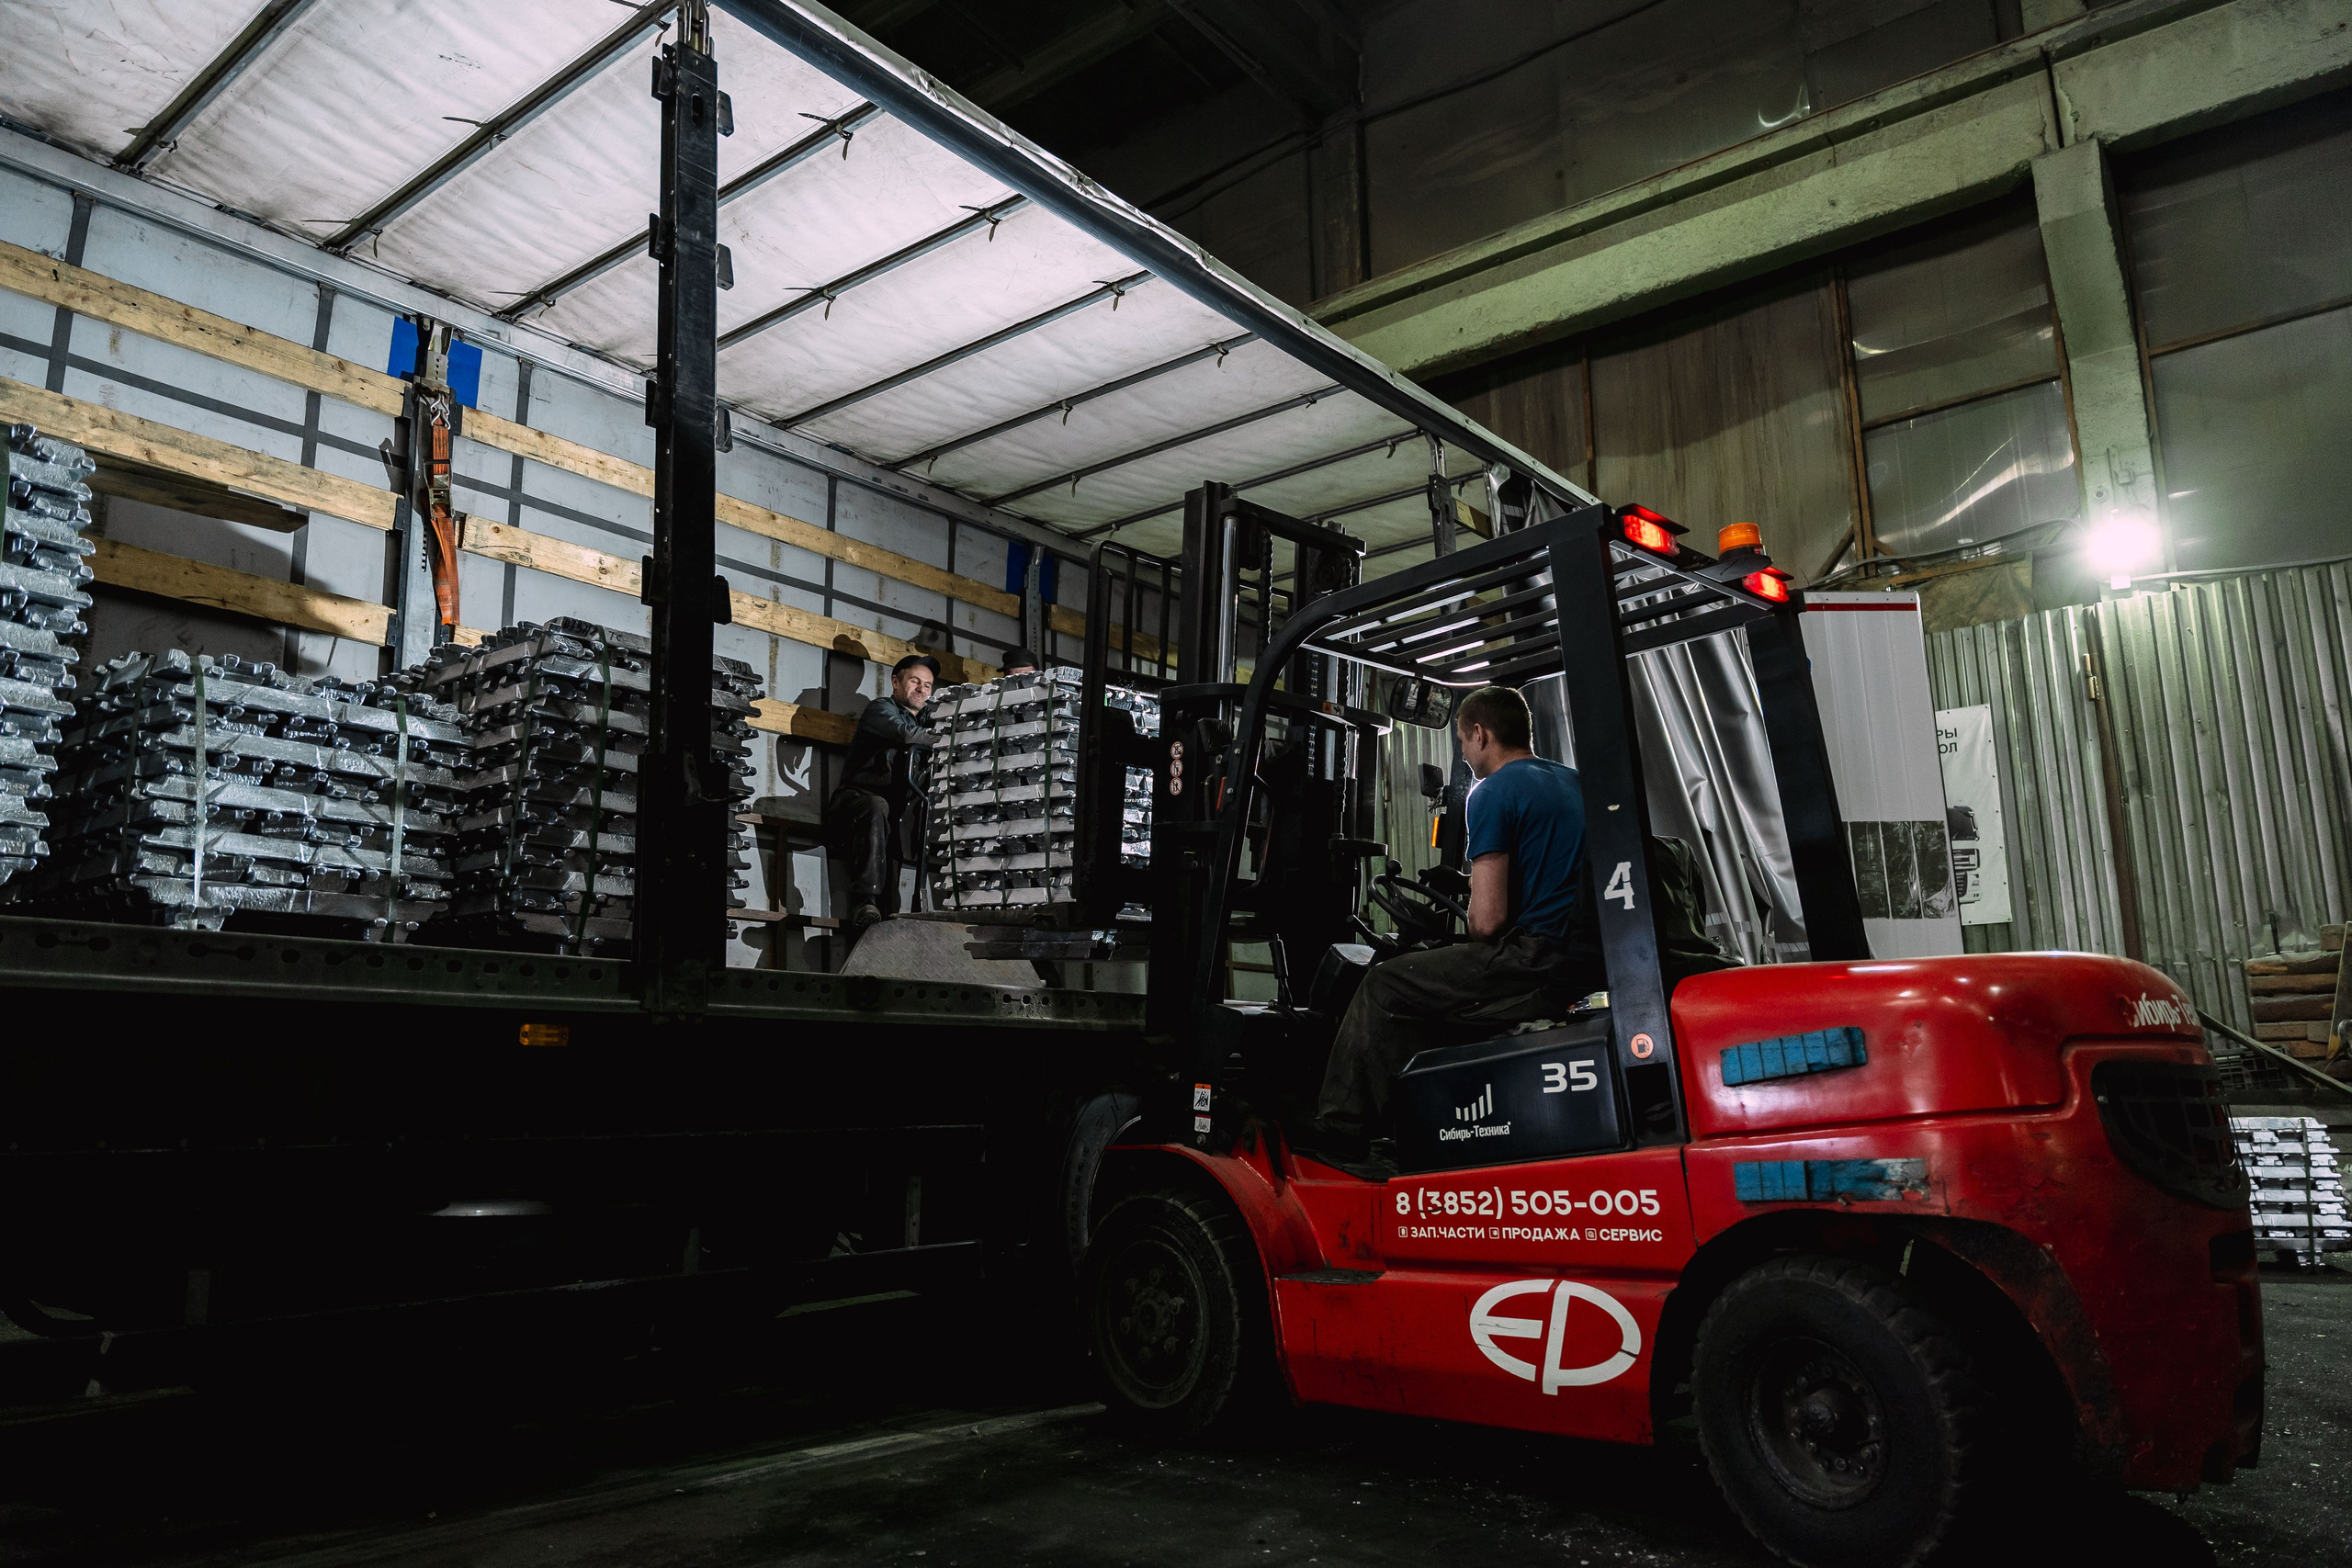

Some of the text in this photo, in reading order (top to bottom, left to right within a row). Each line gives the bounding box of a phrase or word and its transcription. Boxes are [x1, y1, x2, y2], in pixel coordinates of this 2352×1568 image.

[1603, 861, 1635, 910] 4
[1541, 1059, 1598, 1094] 35
[1439, 1123, 1510, 1142] Сибирь-Техника
[1396, 1186, 1661, 1220] 8 (3852) 505-005
[1410, 1225, 1664, 1242] ЗАП.ЧАСТИ ПРОДАЖА СЕРВИС
